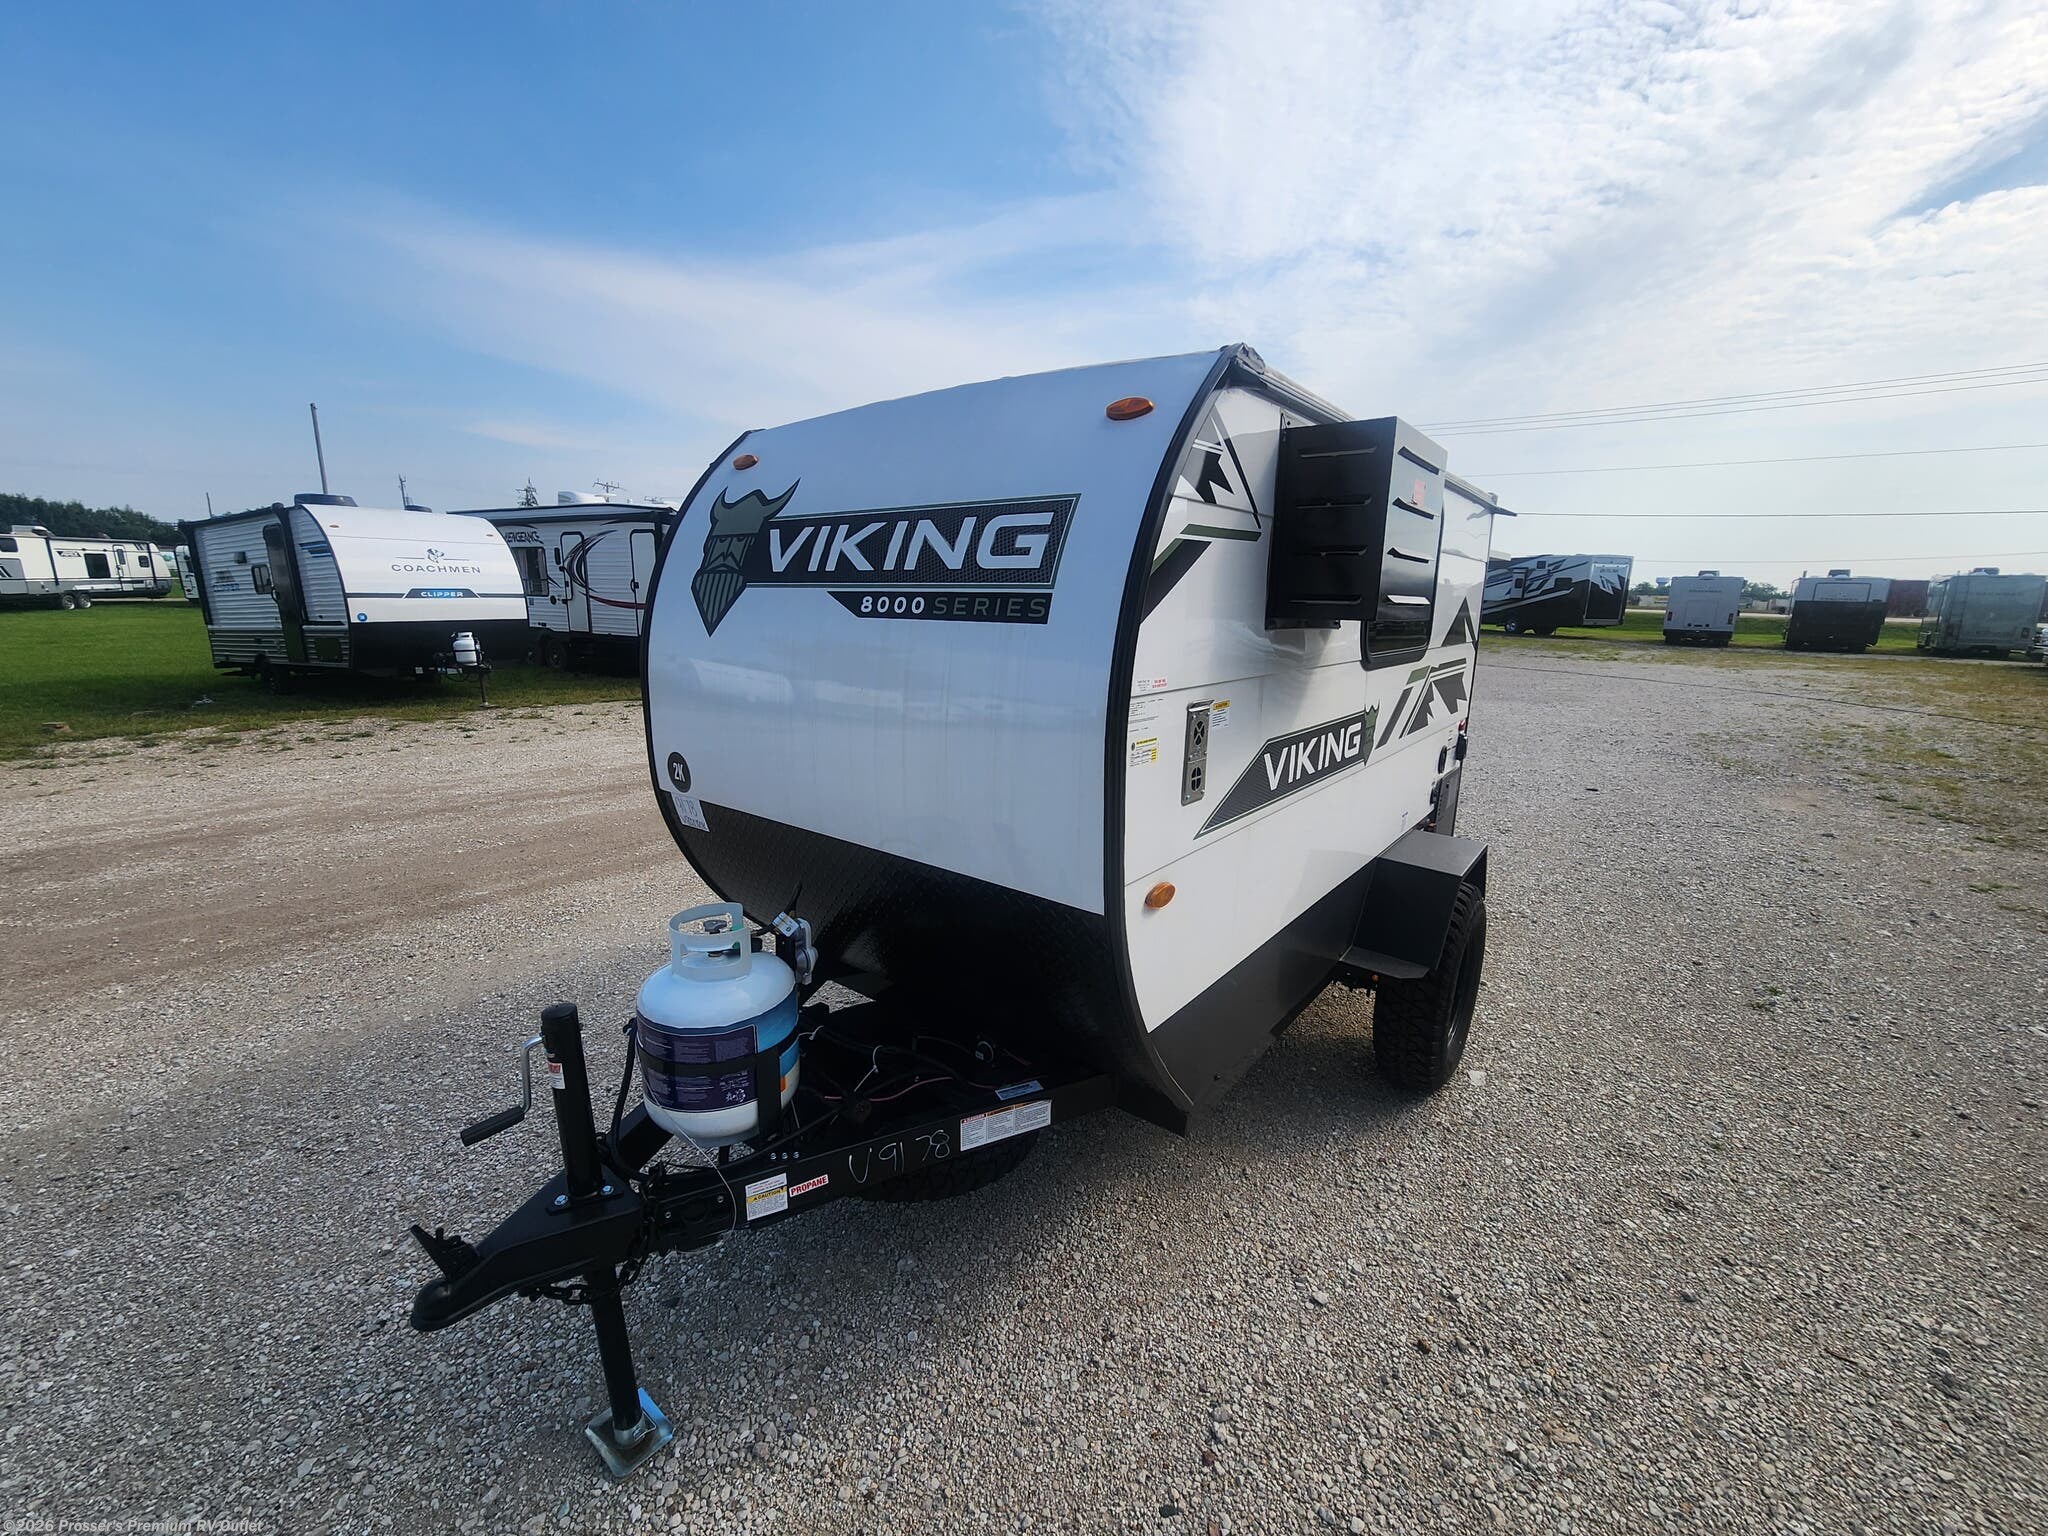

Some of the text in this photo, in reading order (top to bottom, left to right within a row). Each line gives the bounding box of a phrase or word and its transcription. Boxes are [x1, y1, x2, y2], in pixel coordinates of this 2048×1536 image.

[770, 511, 1054, 573] VIKING
[391, 564, 481, 574] COACHMEN
[860, 596, 1046, 617] 8000 SERIES
[1264, 722, 1362, 791] VIKING
[673, 762, 686, 782] 2K
[758, 1189, 781, 1200] CAUTION
[790, 1175, 828, 1196] PROPANE
